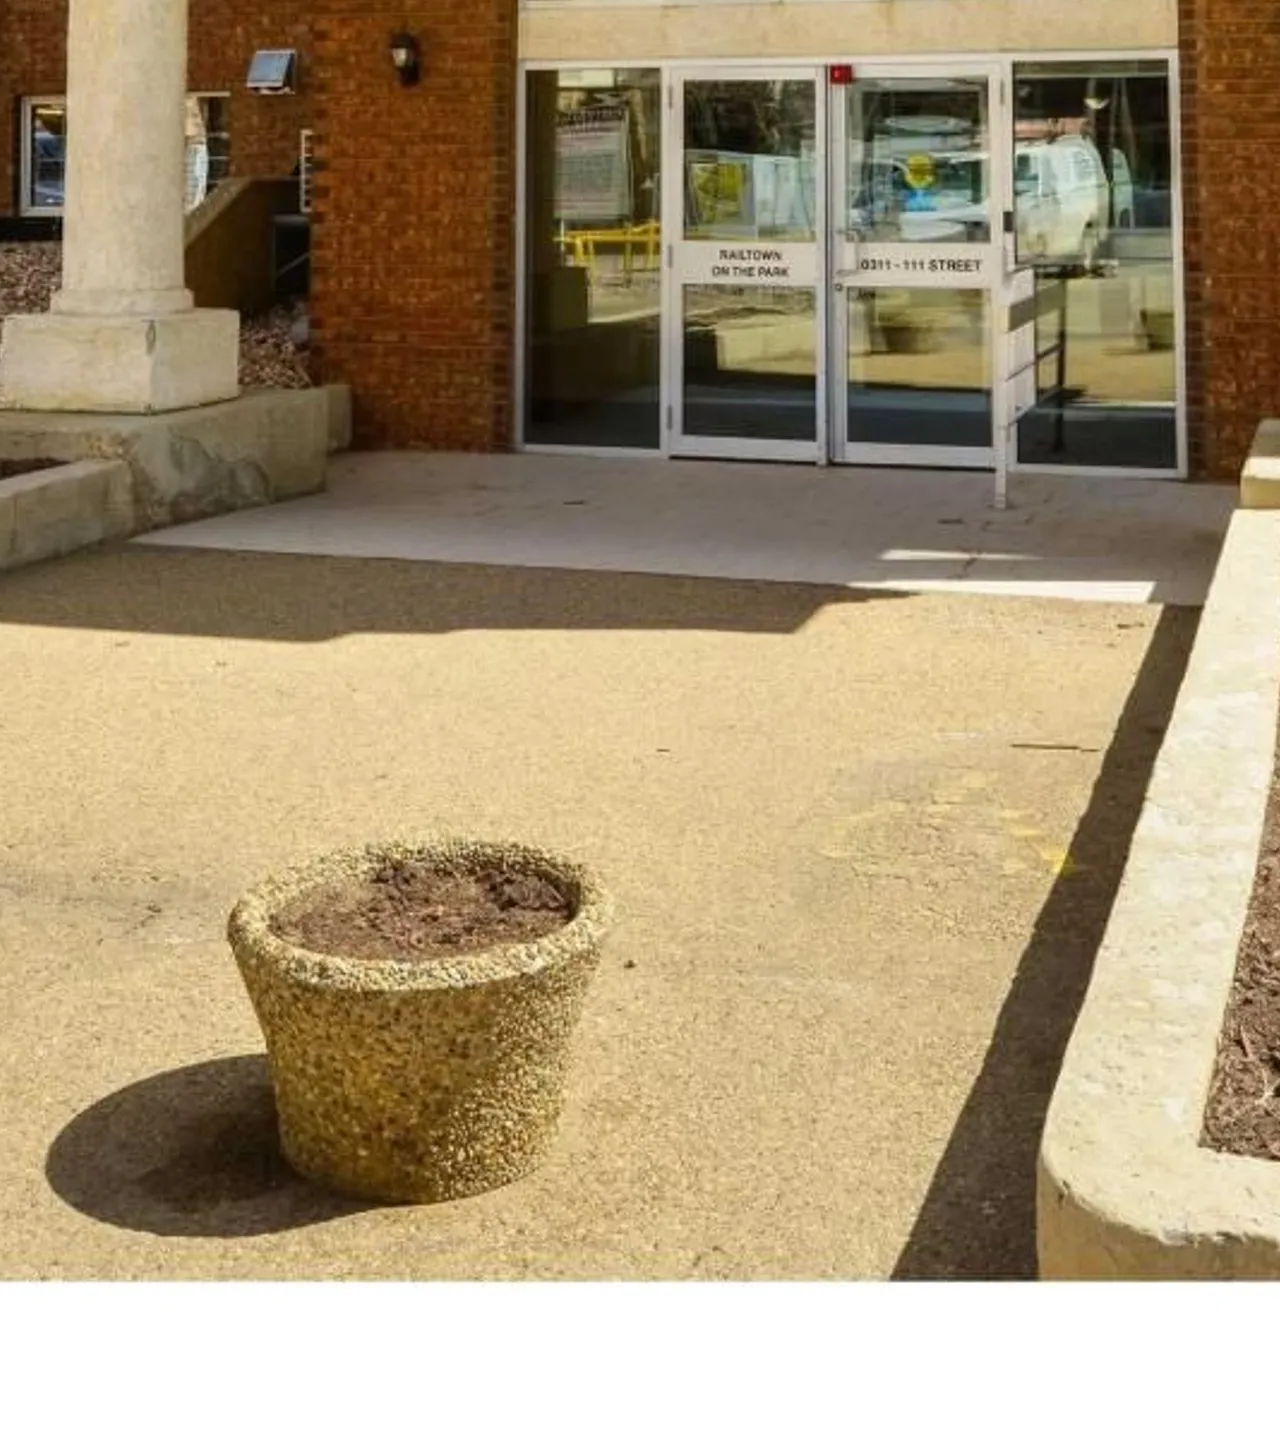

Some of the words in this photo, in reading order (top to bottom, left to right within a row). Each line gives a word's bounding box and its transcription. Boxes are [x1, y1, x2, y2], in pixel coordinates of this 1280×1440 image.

[719, 249, 783, 261] RAILTOWN
[711, 266, 730, 277] ON
[731, 266, 756, 277] THE
[757, 266, 790, 277] PARK
[856, 259, 892, 271] 0311
[902, 260, 925, 271] 111
[928, 259, 981, 272] STREET
